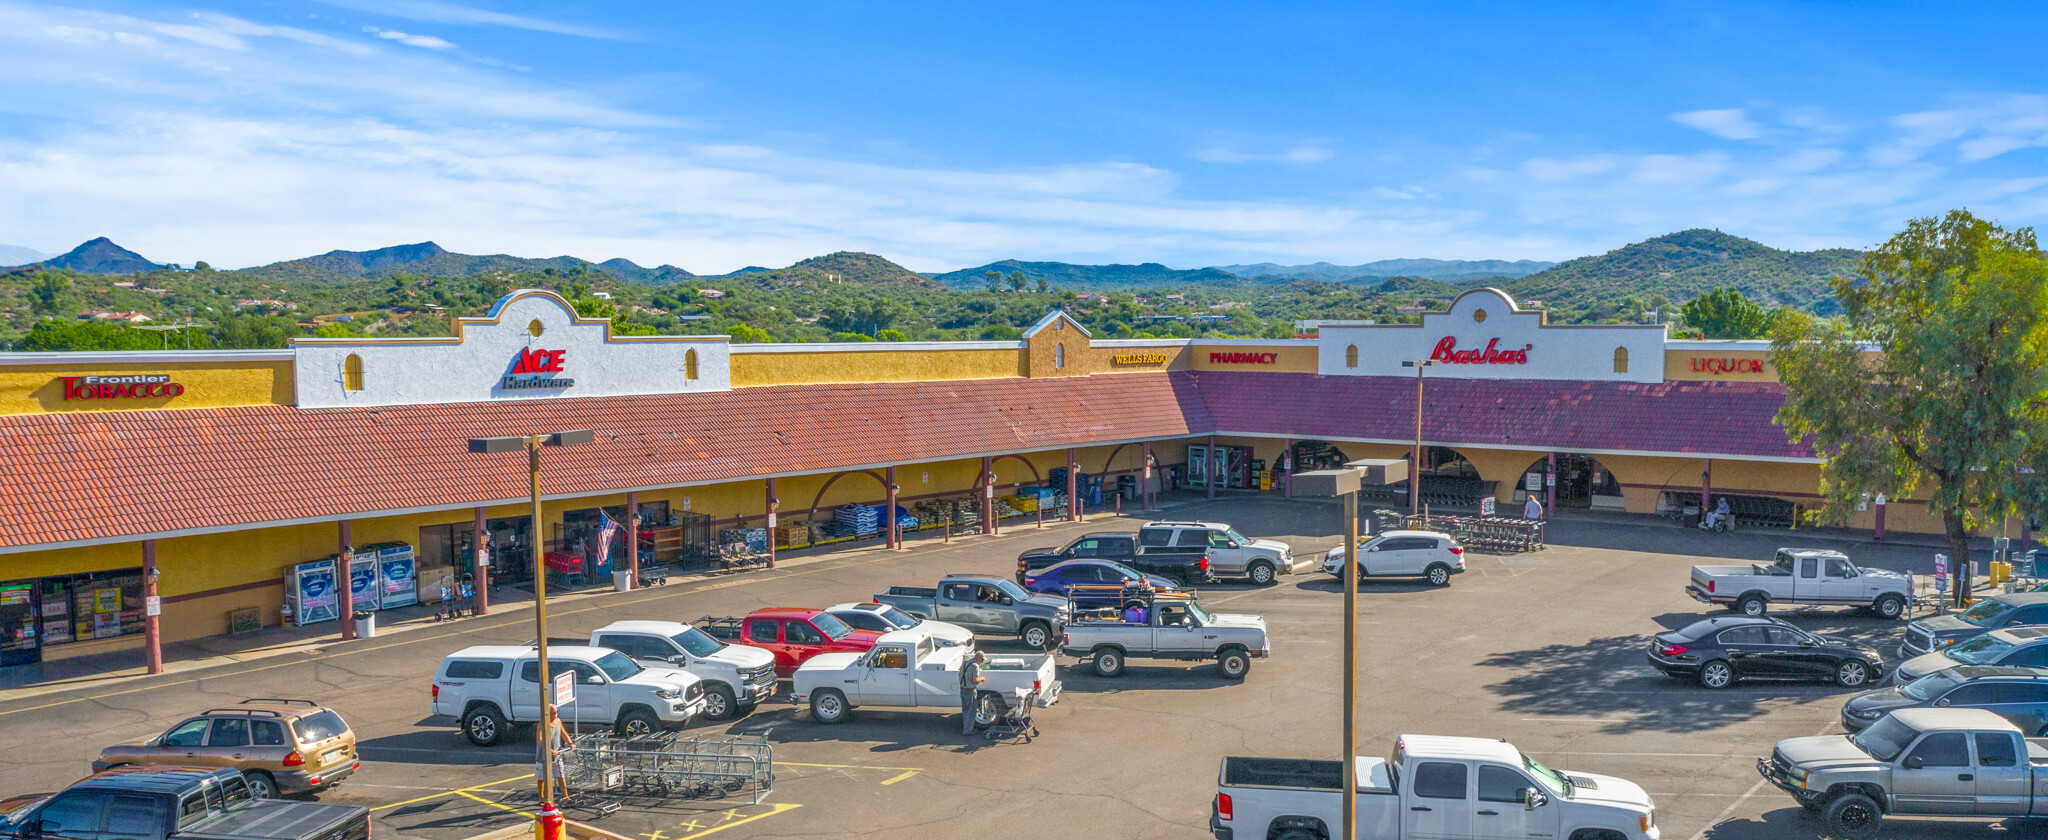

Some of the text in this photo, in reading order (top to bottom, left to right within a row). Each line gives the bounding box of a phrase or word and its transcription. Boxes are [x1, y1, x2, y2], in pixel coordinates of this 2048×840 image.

[1430, 336, 1531, 365] Bashas'
[512, 346, 567, 375] ACE
[1114, 353, 1168, 364] WELLS FARGO
[1209, 352, 1277, 365] PHARMACY
[1690, 358, 1763, 375] LIQUOR
[86, 375, 167, 385] Frontier
[502, 376, 575, 390] Hardware
[59, 376, 185, 401] TOBACCO
